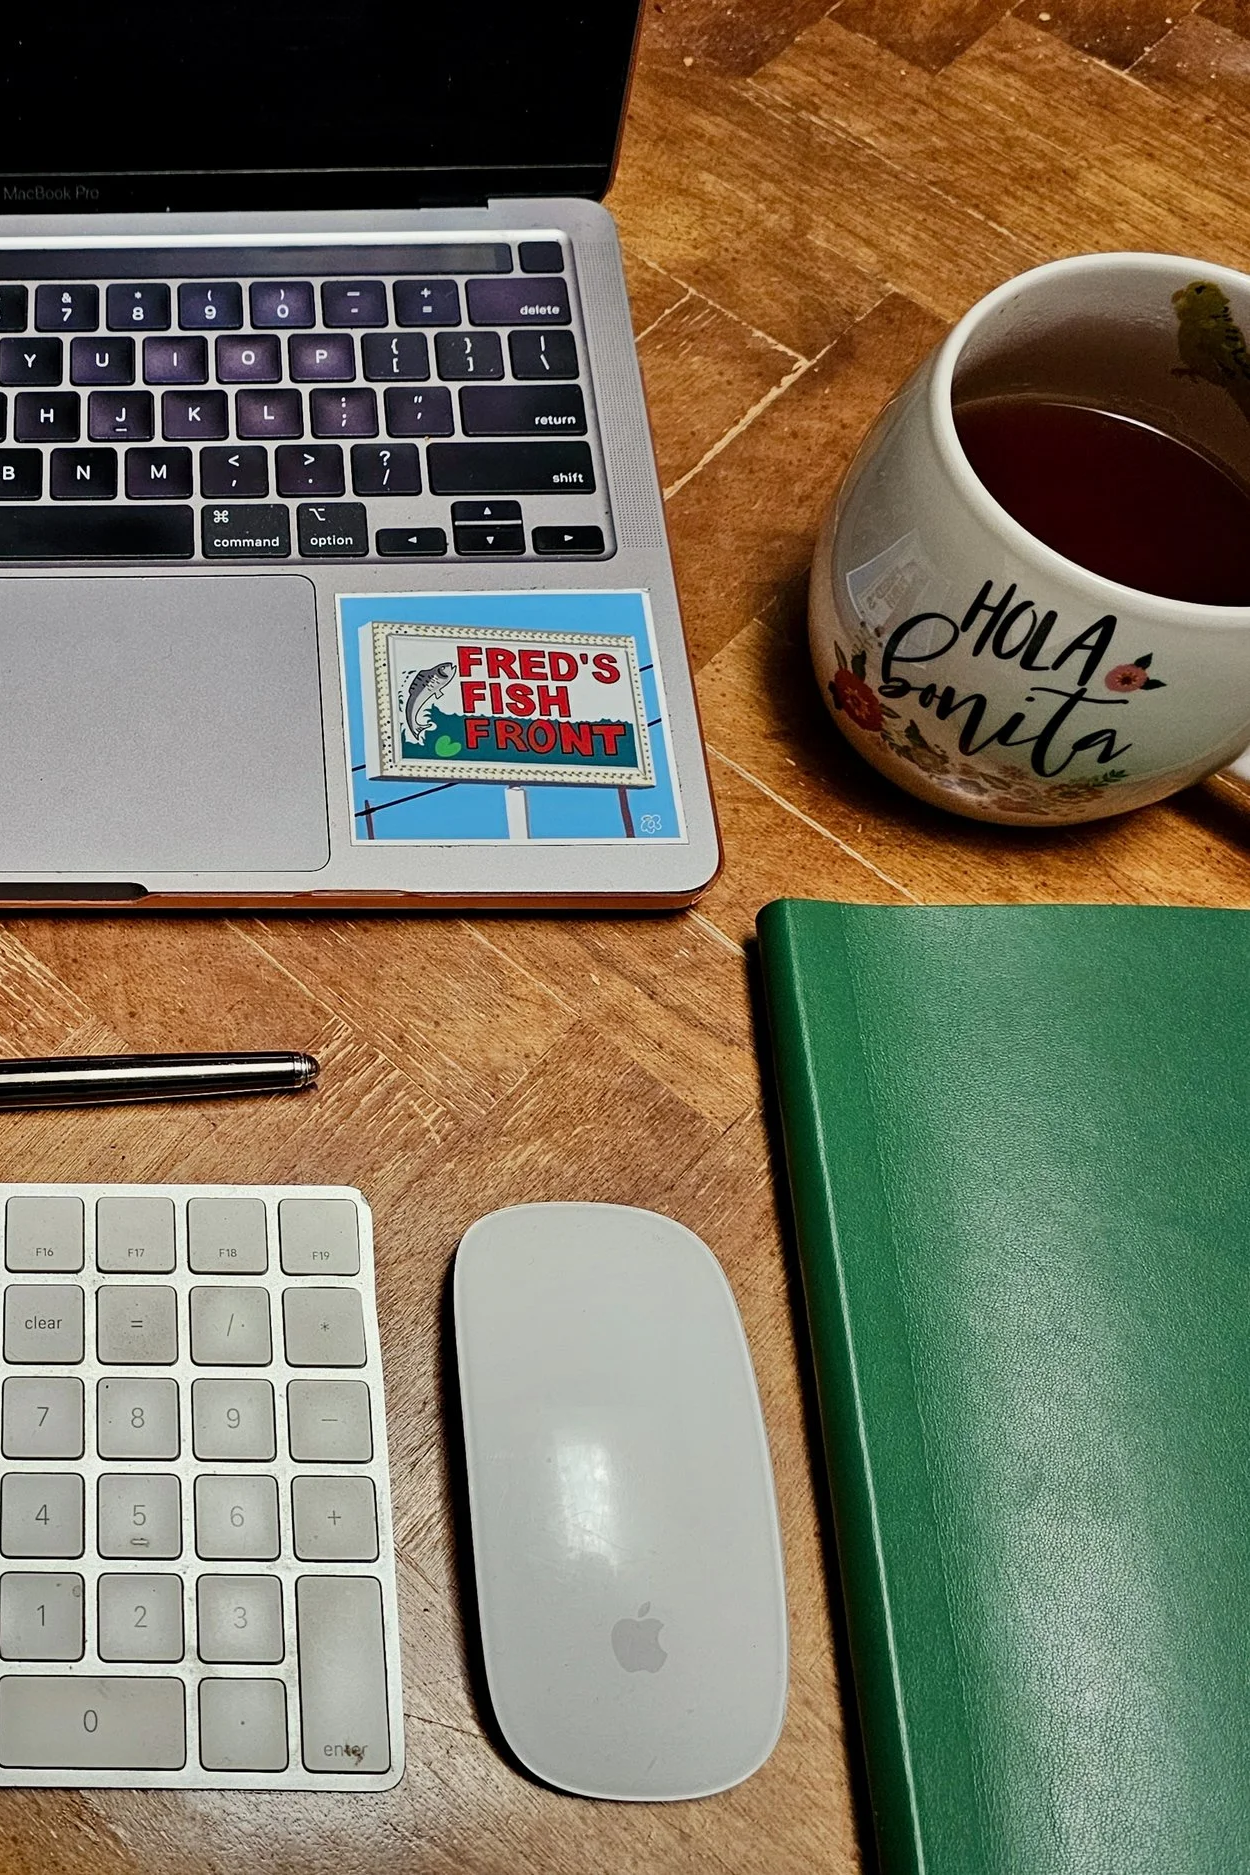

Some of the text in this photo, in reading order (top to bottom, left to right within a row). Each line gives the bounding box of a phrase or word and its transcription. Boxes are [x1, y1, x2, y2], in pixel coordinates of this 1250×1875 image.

[3, 184, 99, 200] MacBook Pro
[62, 308, 72, 321] 7
[133, 307, 143, 320] 8
[205, 306, 216, 319] 9
[277, 304, 288, 318] 0
[520, 305, 559, 315] delete
[24, 354, 36, 367] Y
[96, 353, 108, 367] U
[242, 351, 255, 365] O
[316, 350, 327, 363] P
[41, 409, 53, 422] H
[116, 408, 125, 422] J
[189, 407, 200, 421] K
[264, 406, 274, 419] L
[535, 416, 576, 425] return
[3, 466, 15, 480] B
[77, 466, 90, 479] N
[151, 465, 166, 479] M
[553, 473, 583, 482] shift
[214, 537, 279, 547] command
[311, 535, 352, 547] option
[961, 580, 1117, 687] HOLA
[457, 646, 621, 684] FRED'S
[461, 681, 571, 718] FISH
[464, 718, 626, 756] FRONT
[36, 1248, 53, 1256] F16
[128, 1249, 144, 1257] F17
[219, 1249, 237, 1257] F18
[313, 1252, 329, 1260] F19
[25, 1316, 62, 1329] clear
[37, 1407, 49, 1426] 7
[131, 1408, 144, 1428] 8
[227, 1408, 240, 1428] 9
[35, 1505, 49, 1525] 4
[133, 1505, 146, 1525] 5
[230, 1506, 244, 1527] 6
[134, 1606, 147, 1627] 2
[234, 1607, 247, 1629] 3
[84, 1710, 97, 1732] 0
[323, 1742, 368, 1757] enter
